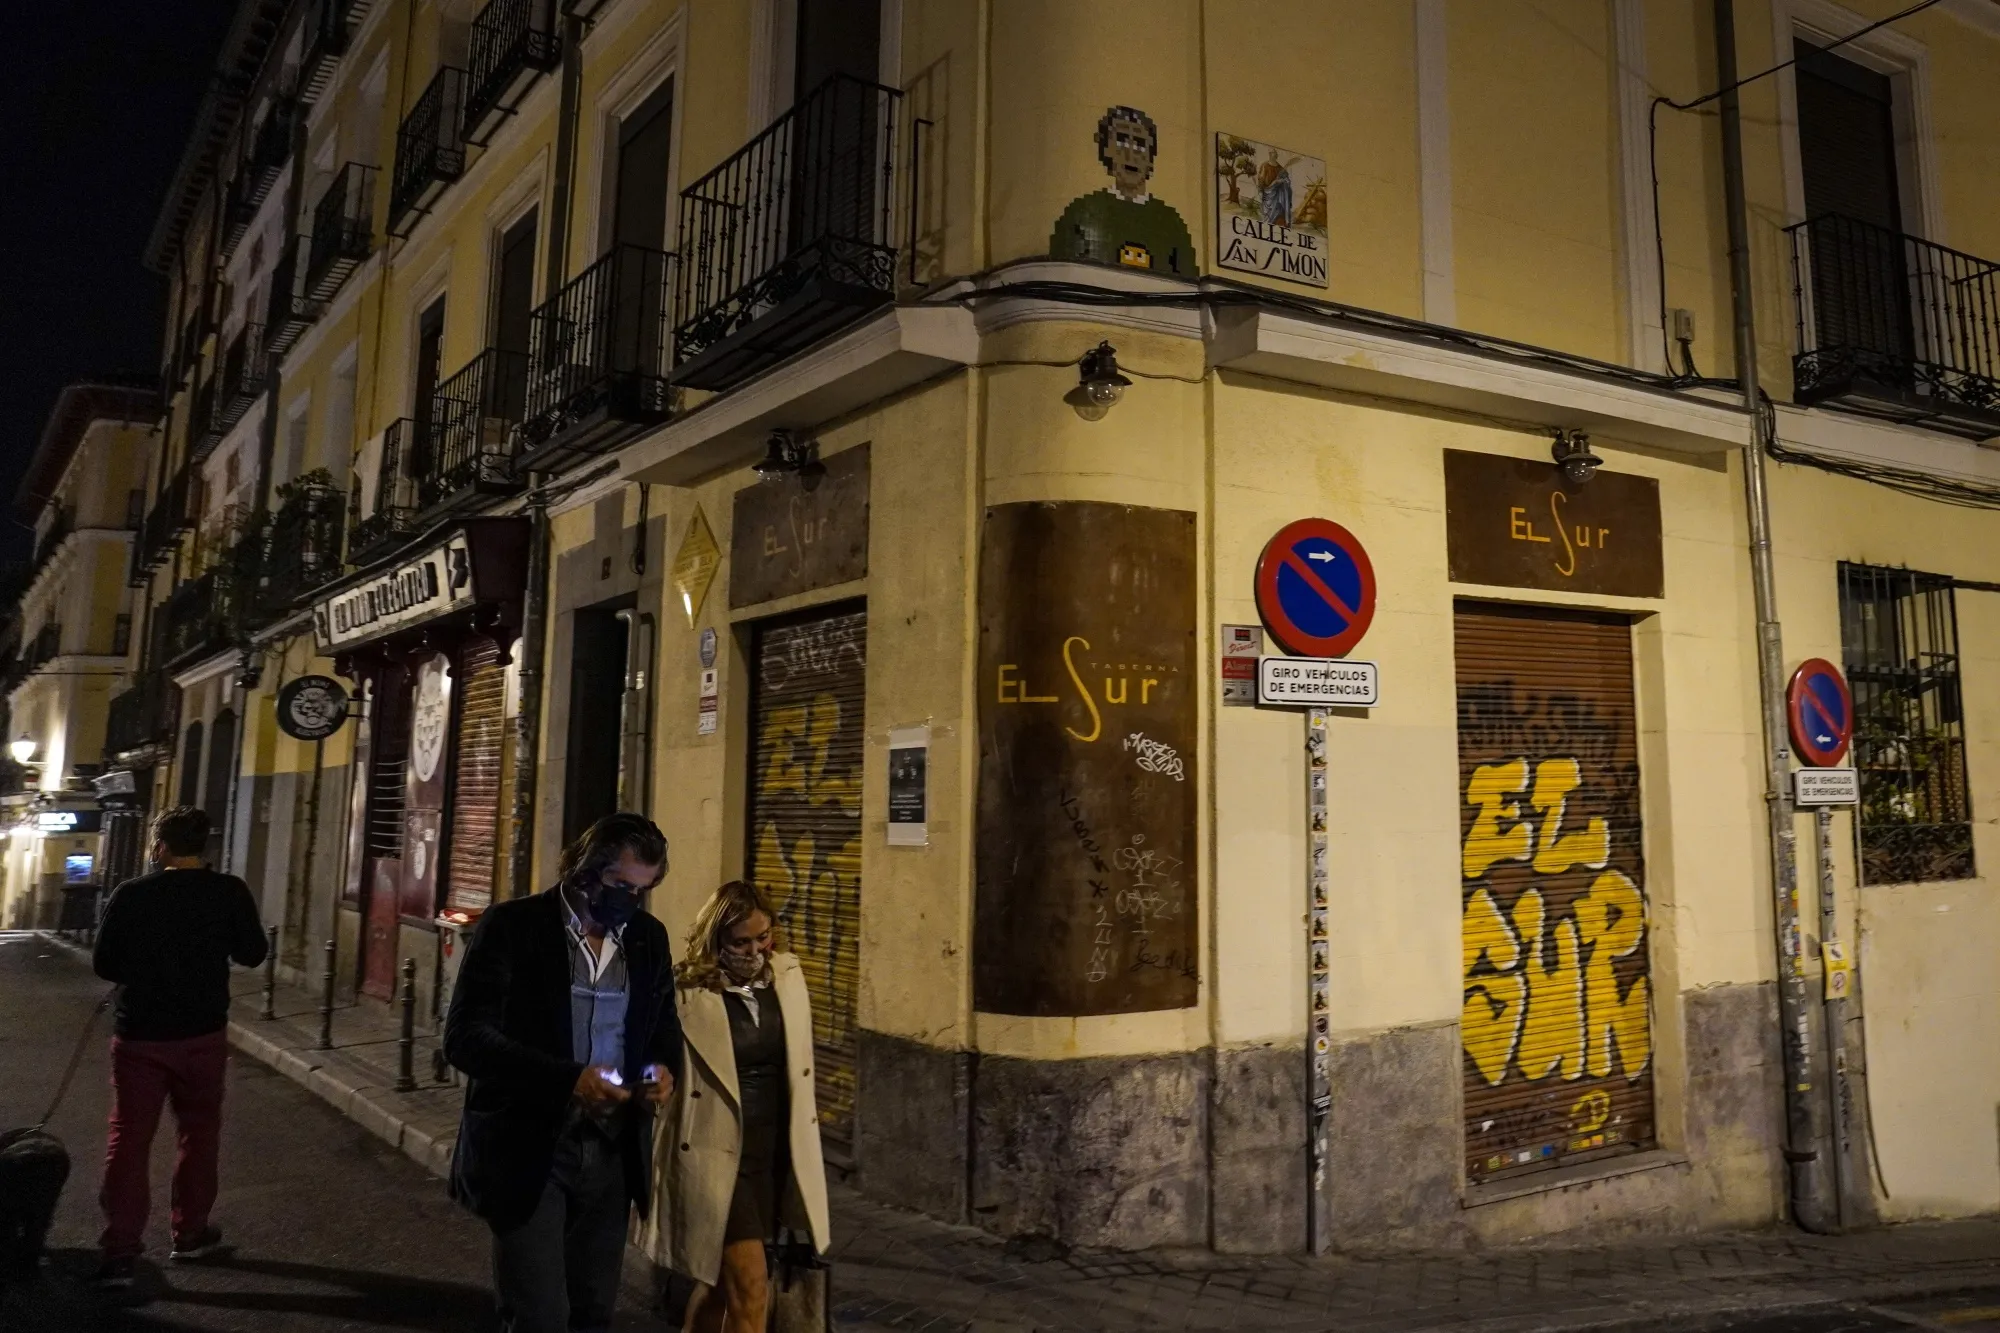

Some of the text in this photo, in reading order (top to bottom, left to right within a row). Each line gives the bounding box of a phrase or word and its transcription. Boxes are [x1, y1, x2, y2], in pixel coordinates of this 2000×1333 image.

[1232, 215, 1317, 251] CALLE DE
[1221, 238, 1258, 265] SAN
[788, 495, 828, 579] Sur
[1510, 491, 1610, 577] EL Sur
[1090, 662, 1180, 673] TABERNA
[1272, 667, 1368, 682] GIRO VEHICULOS
[998, 636, 1158, 742] EL Sur
[1270, 682, 1285, 693] DE
[1290, 683, 1370, 696] EMERGENCIAS
[1801, 787, 1854, 796] DE EMERGENCIAS
[1802, 776, 1853, 785] GIRO VEHICULOS
[1463, 756, 1611, 879] EL
[1461, 869, 1650, 1086] SUR
